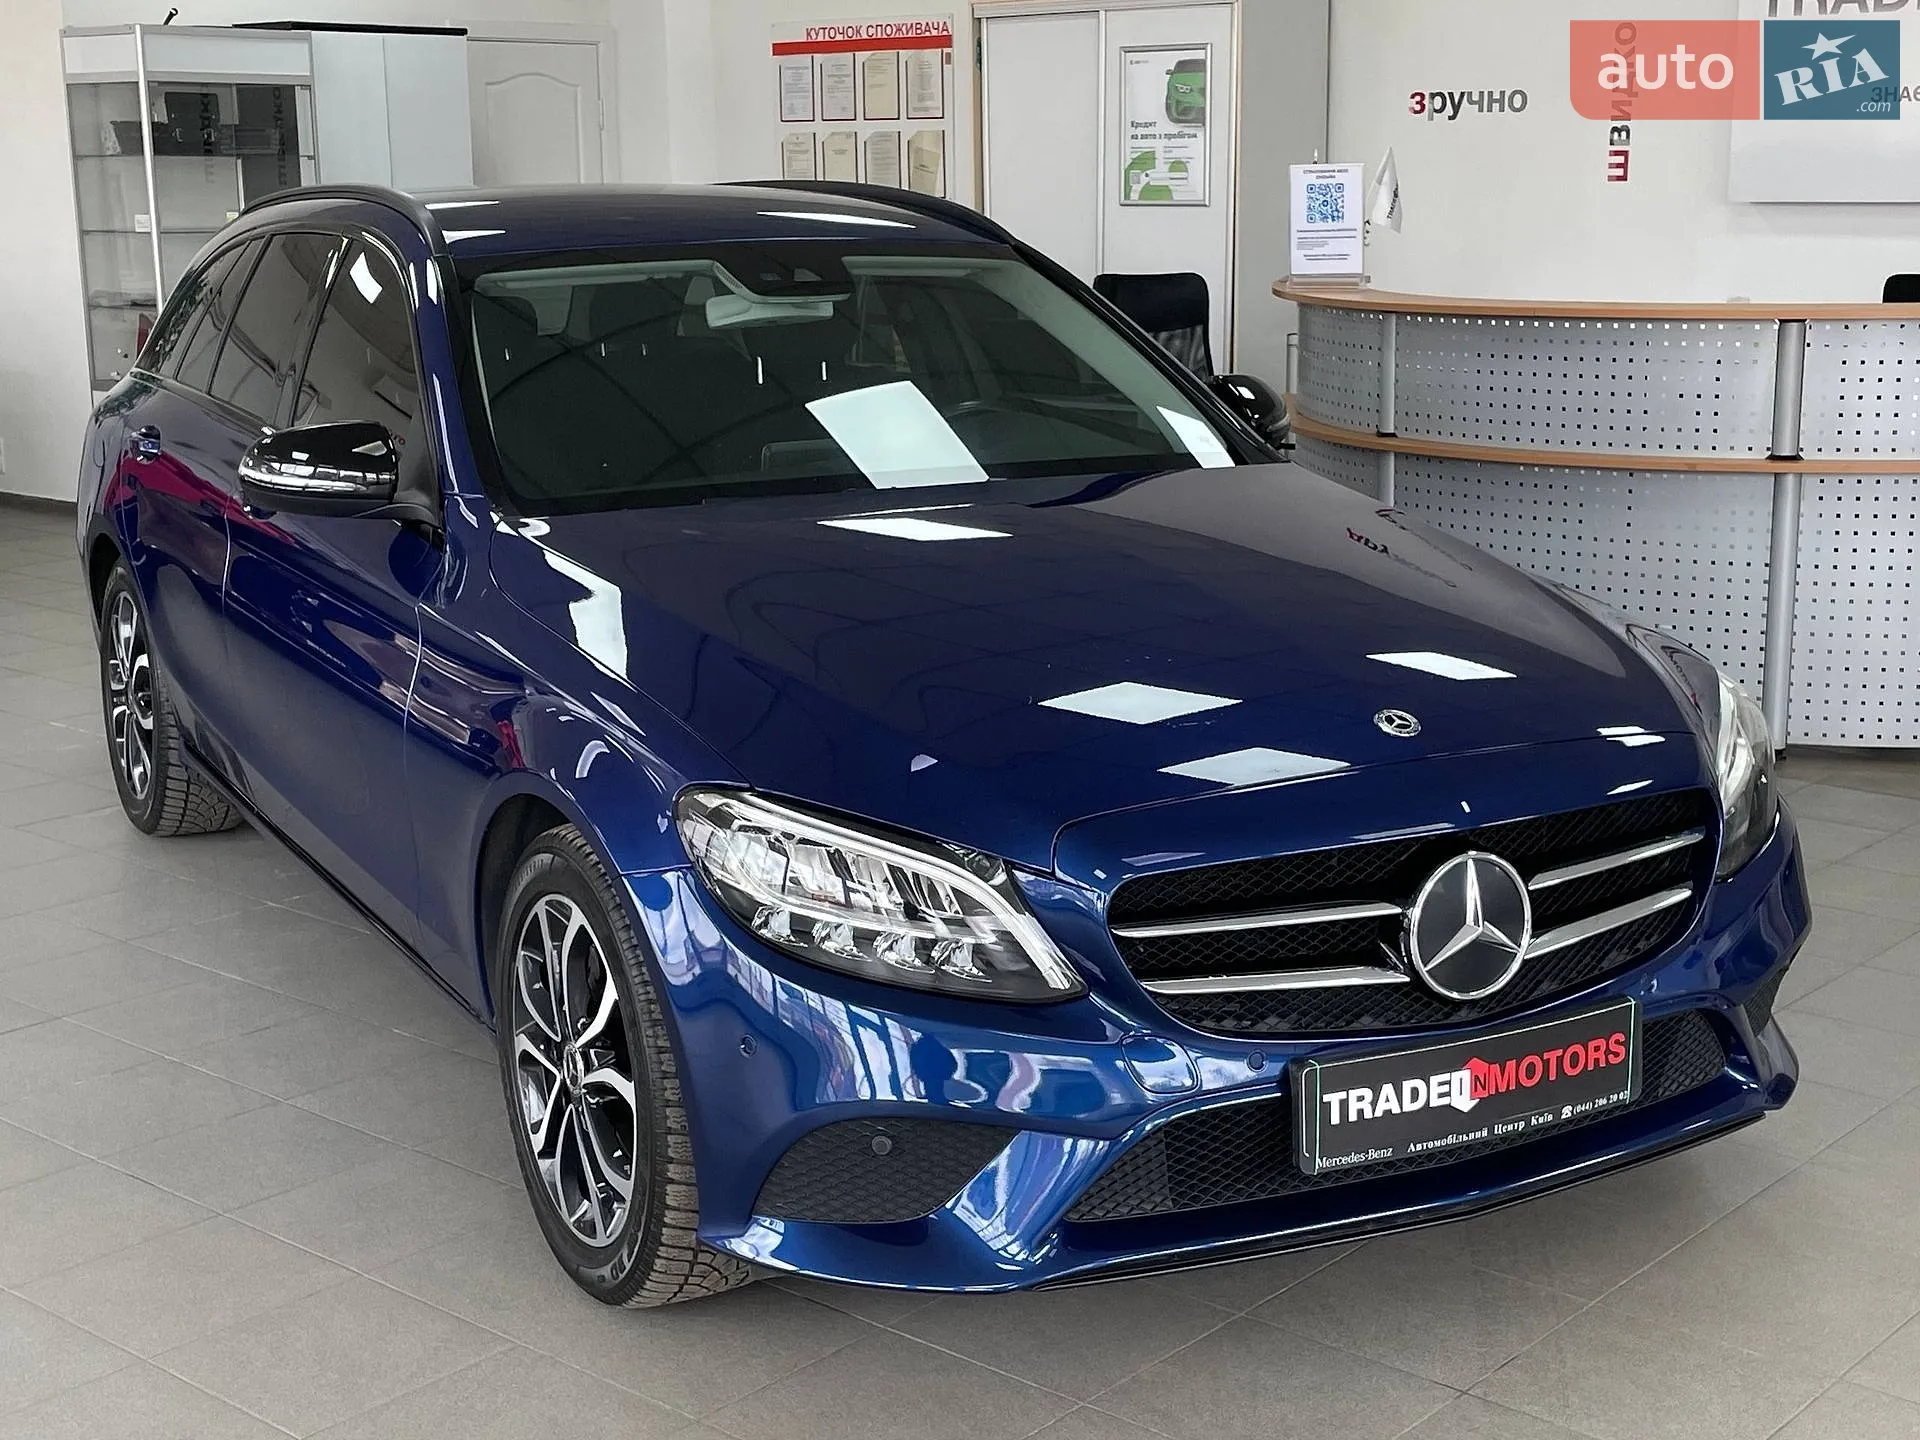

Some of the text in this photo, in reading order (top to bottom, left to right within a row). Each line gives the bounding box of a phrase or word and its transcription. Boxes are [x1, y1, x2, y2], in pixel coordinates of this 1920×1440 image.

[806, 21, 950, 41] КУТОЧОК СПОЖИВАЧА
[1409, 89, 1528, 121] зручно
[1407, 1112, 1554, 1154] Автомобільний Центр Київ
[1316, 1147, 1394, 1170] Mercedes-Benz
